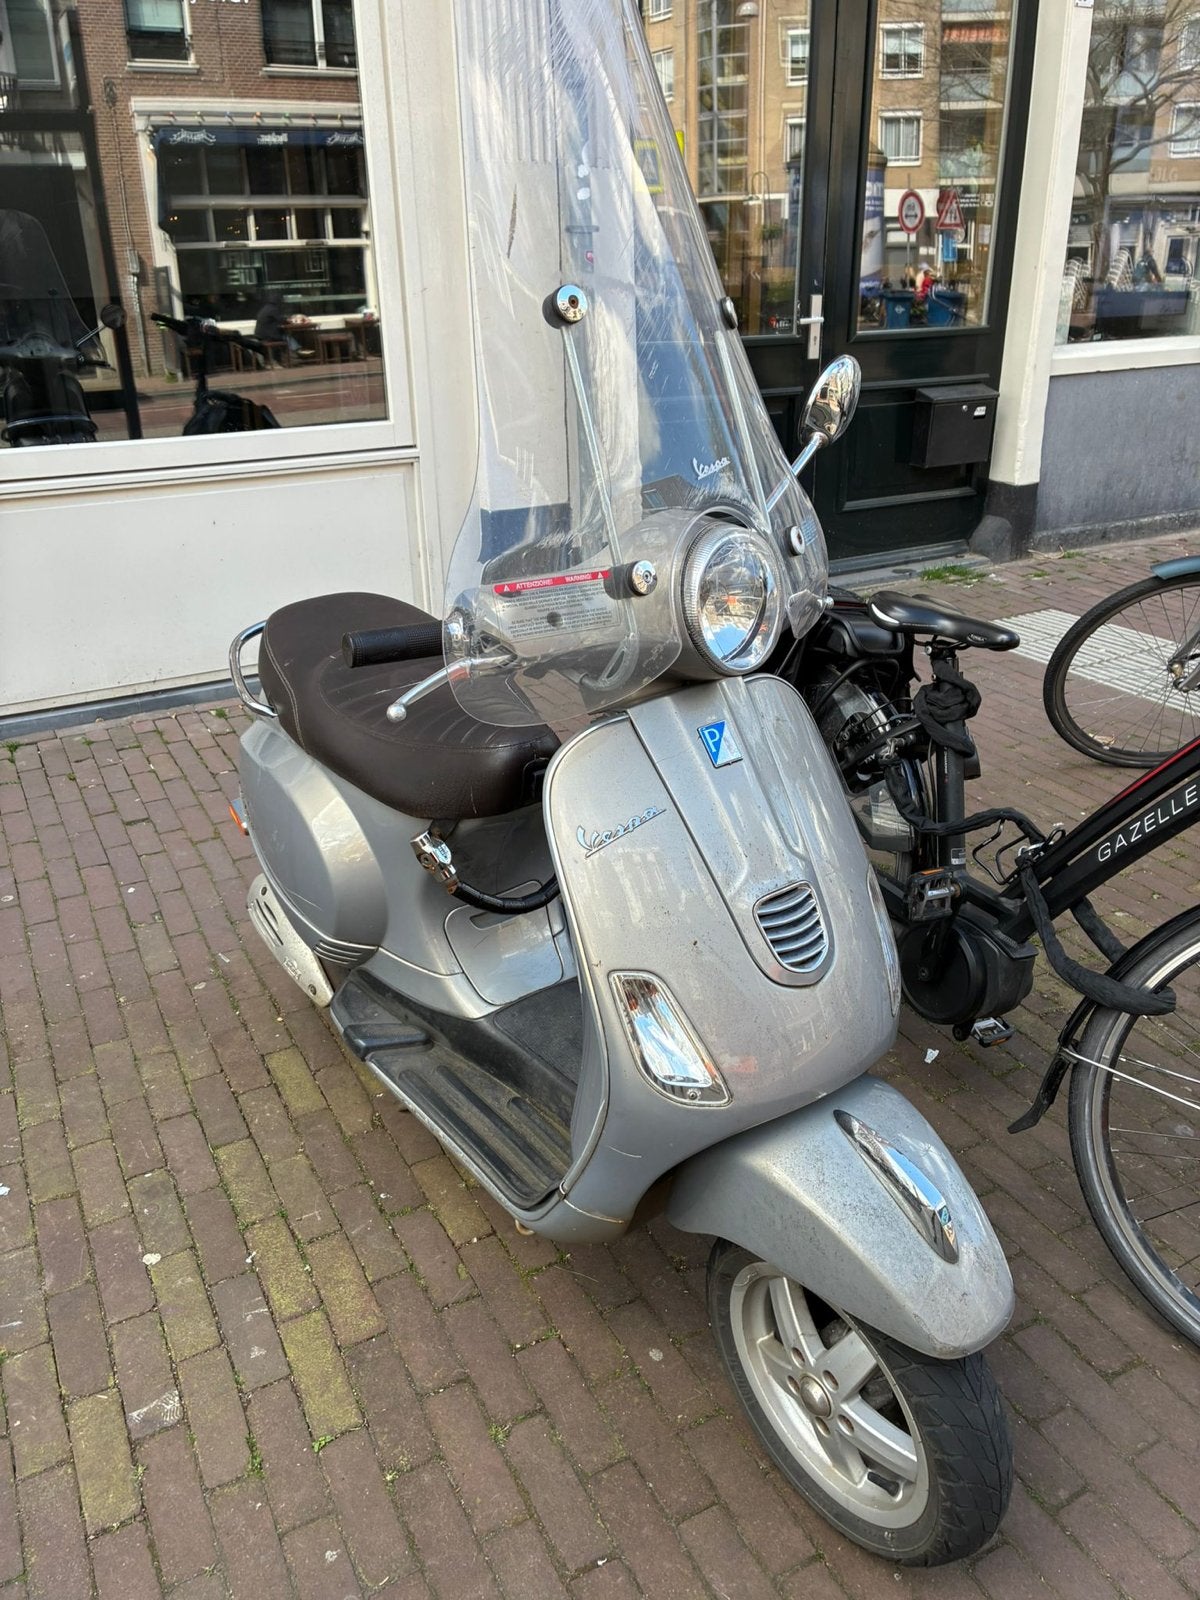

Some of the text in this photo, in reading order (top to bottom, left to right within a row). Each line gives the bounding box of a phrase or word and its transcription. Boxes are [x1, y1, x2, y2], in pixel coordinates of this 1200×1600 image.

[692, 456, 731, 480] Vespa
[703, 728, 720, 752] P
[576, 805, 667, 859] Vespa
[1097, 784, 1198, 862] GAZELLE
